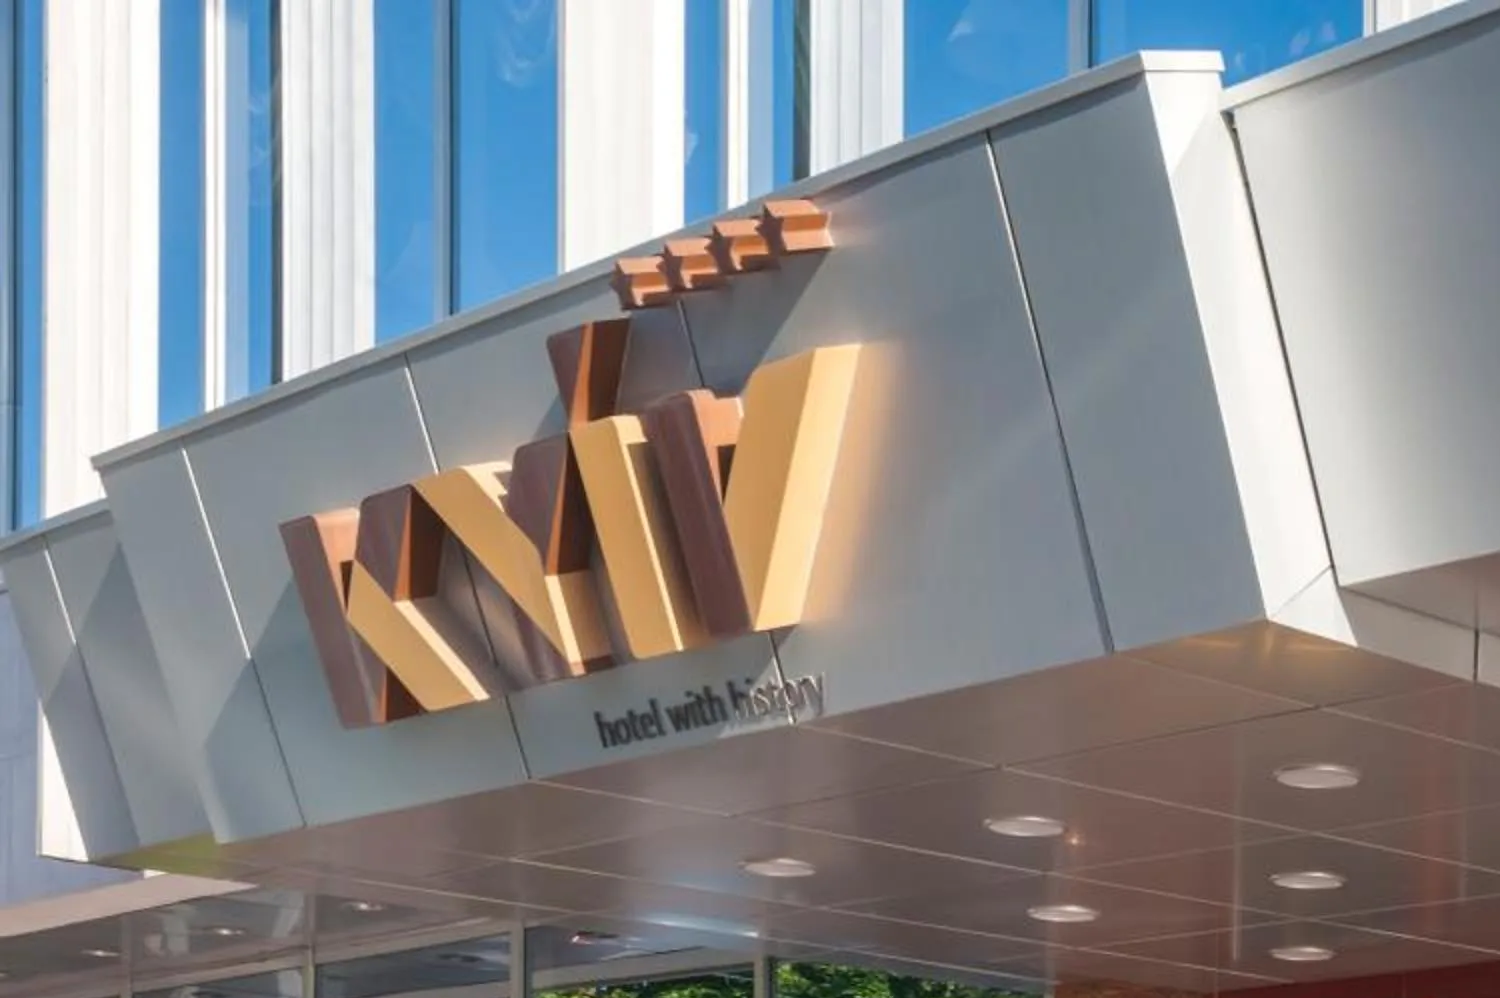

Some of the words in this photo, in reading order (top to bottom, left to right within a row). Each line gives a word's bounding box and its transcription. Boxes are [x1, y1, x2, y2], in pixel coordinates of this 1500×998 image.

[594, 698, 666, 748] hotel
[664, 685, 729, 733] with
[726, 671, 825, 721] history
